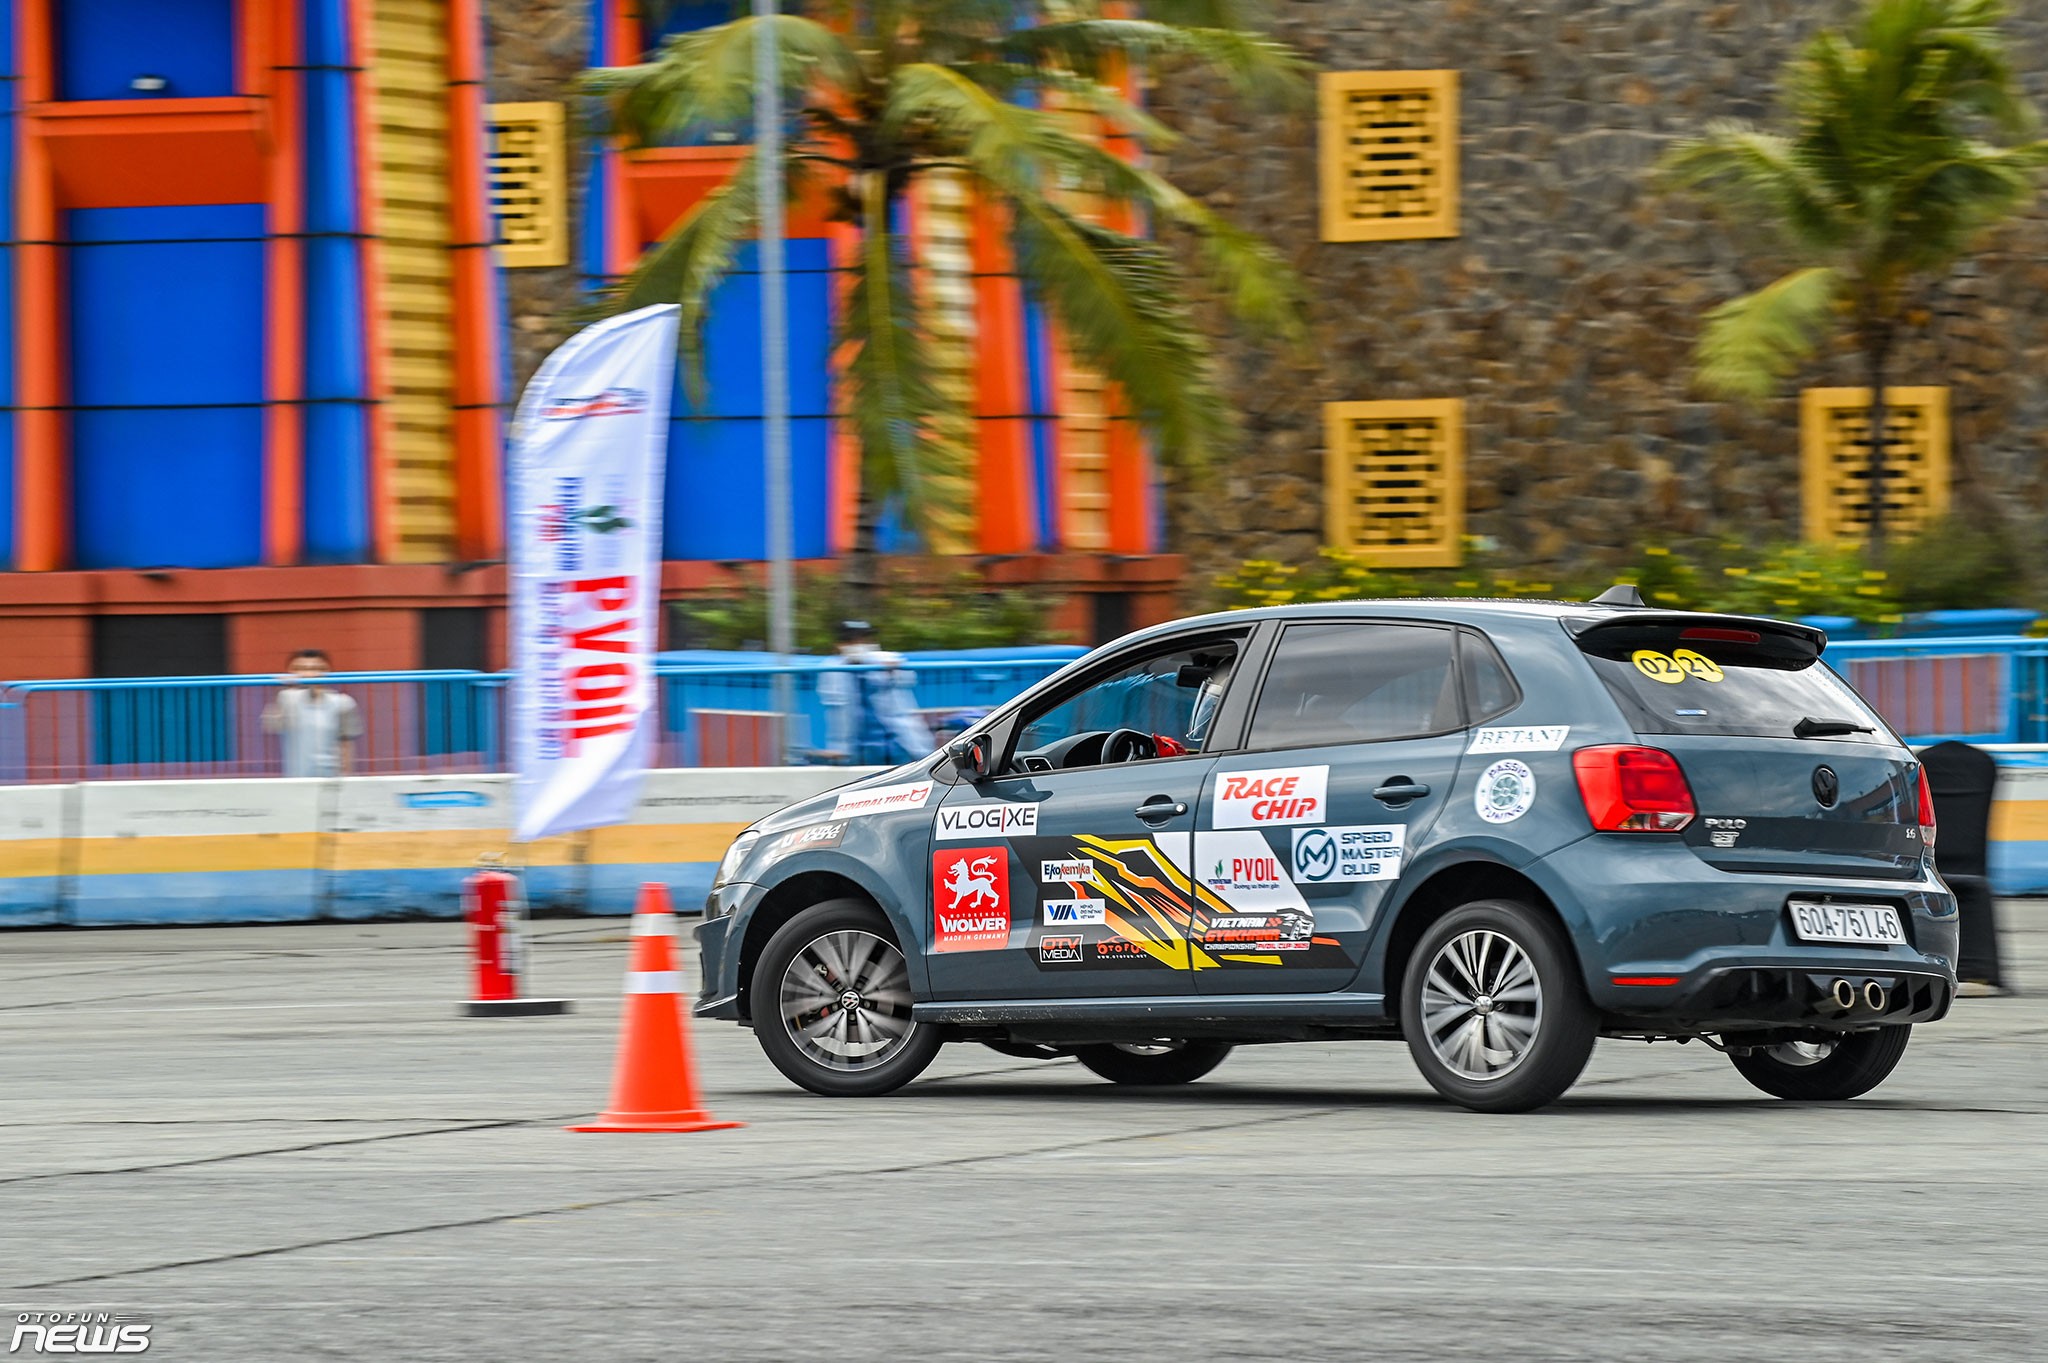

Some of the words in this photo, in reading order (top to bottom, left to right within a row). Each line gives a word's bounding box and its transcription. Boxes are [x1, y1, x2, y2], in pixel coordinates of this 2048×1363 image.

[566, 576, 638, 756] PVOIL
[1640, 657, 1679, 675] 02
[1223, 777, 1300, 800] RACE
[835, 798, 883, 813] GENERAL
[884, 794, 909, 804] TIRE
[1251, 798, 1318, 821] CHIP
[1704, 817, 1747, 829] POLO
[1341, 831, 1392, 844] SPEED
[1341, 847, 1402, 860] MASTER
[1044, 863, 1092, 880] Ekokemika
[1232, 858, 1280, 882] PVOIL
[1342, 863, 1381, 876] CLUB
[939, 914, 1007, 933] WOLVER
[1798, 907, 1899, 939] 60A-751.46
[1043, 950, 1081, 960] MEDIA
